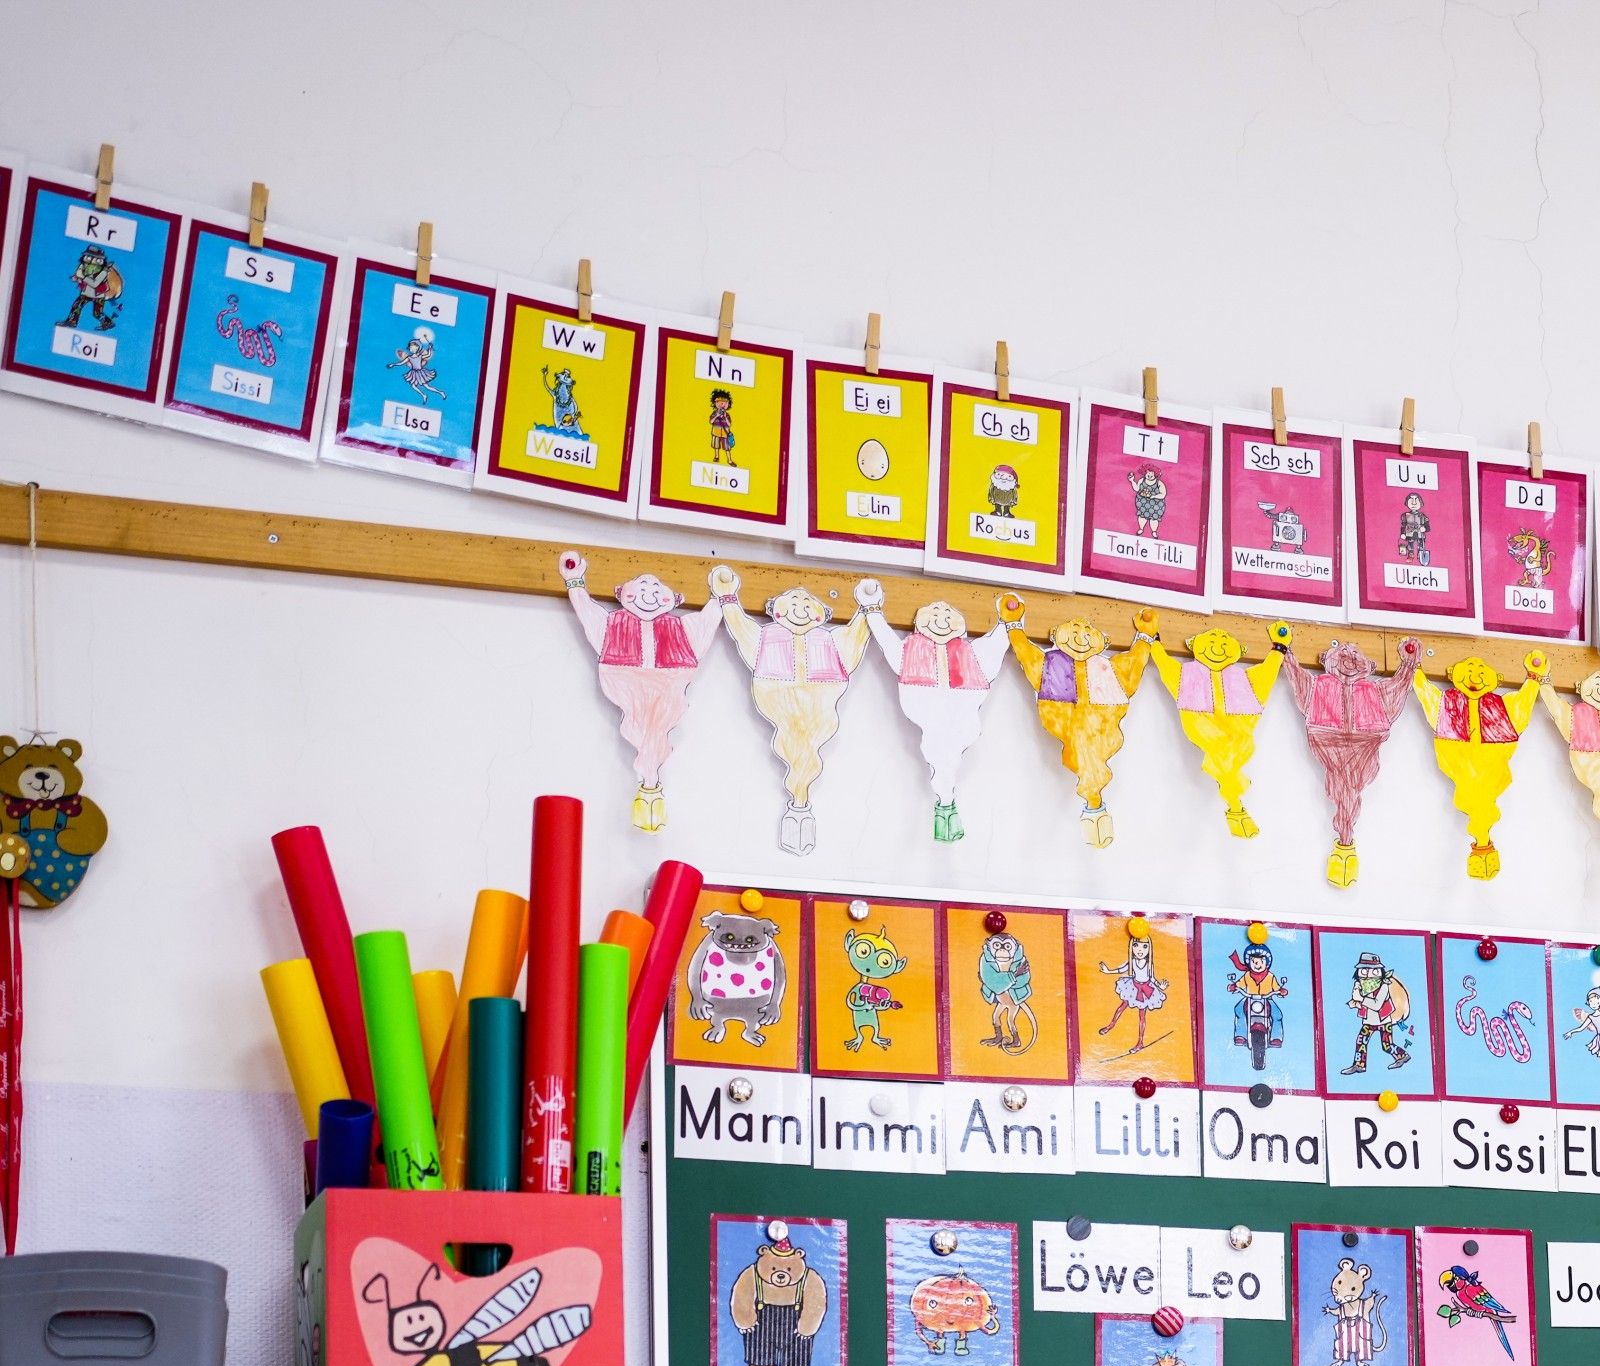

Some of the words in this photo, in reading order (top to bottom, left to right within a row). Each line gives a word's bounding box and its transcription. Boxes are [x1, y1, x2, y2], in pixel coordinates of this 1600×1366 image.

[87, 215, 100, 237] R
[107, 226, 118, 242] r
[246, 258, 258, 278] S
[265, 269, 275, 284] s
[410, 292, 422, 315] E
[429, 304, 441, 318] e
[70, 335, 99, 359] Roi
[552, 325, 573, 348] W
[582, 339, 597, 354] w
[707, 356, 723, 378] N
[730, 365, 743, 382] n
[221, 372, 262, 400] Sissi
[854, 388, 870, 409] Ei
[876, 395, 891, 412] ei
[981, 411, 1004, 434] Ch
[1010, 419, 1030, 438] ch
[533, 438, 593, 465] Wassil
[1138, 433, 1150, 450] T
[1157, 435, 1164, 455] t
[1251, 445, 1281, 467] Sch
[1288, 454, 1314, 473] sch
[701, 467, 739, 489] Nino
[1398, 465, 1410, 484] U
[1417, 473, 1427, 486] u
[857, 495, 891, 516] Eilin
[1519, 486, 1531, 506] D
[1534, 487, 1544, 507] d
[975, 516, 1030, 540] Rochus
[1106, 535, 1148, 556] Tante
[1154, 543, 1184, 564] Tilli
[1235, 551, 1330, 576] Wettermaschine
[1395, 566, 1440, 588] Ulrich
[1512, 590, 1547, 609] Dodo
[680, 1084, 803, 1144] Mam
[820, 1096, 938, 1155] Immi
[960, 1099, 1058, 1156] Ami
[1095, 1101, 1180, 1158] Lilli
[1209, 1107, 1319, 1165] Oma
[1355, 1117, 1421, 1170] Roi
[1453, 1118, 1546, 1175] Sissi
[1039, 1239, 1155, 1295] Löwe
[1187, 1247, 1261, 1300] Leo
